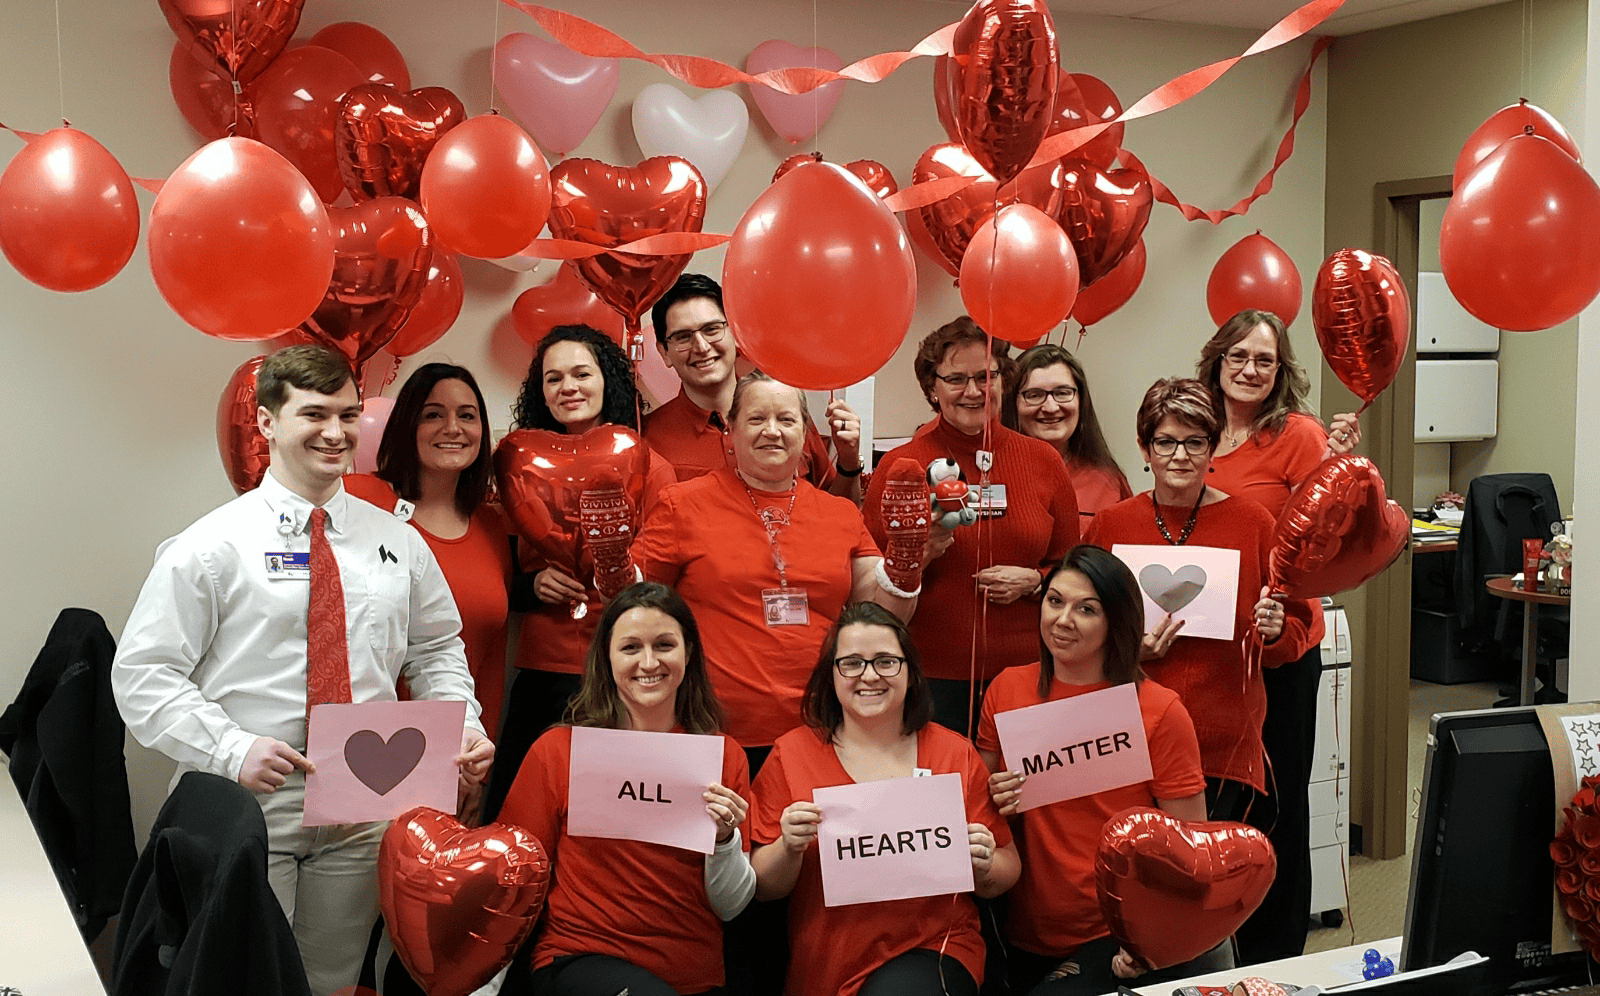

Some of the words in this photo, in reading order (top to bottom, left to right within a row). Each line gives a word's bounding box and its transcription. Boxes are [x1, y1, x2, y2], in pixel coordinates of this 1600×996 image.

[1021, 731, 1132, 777] MATTER
[617, 780, 672, 804] ALL
[836, 826, 952, 861] HEARTS
